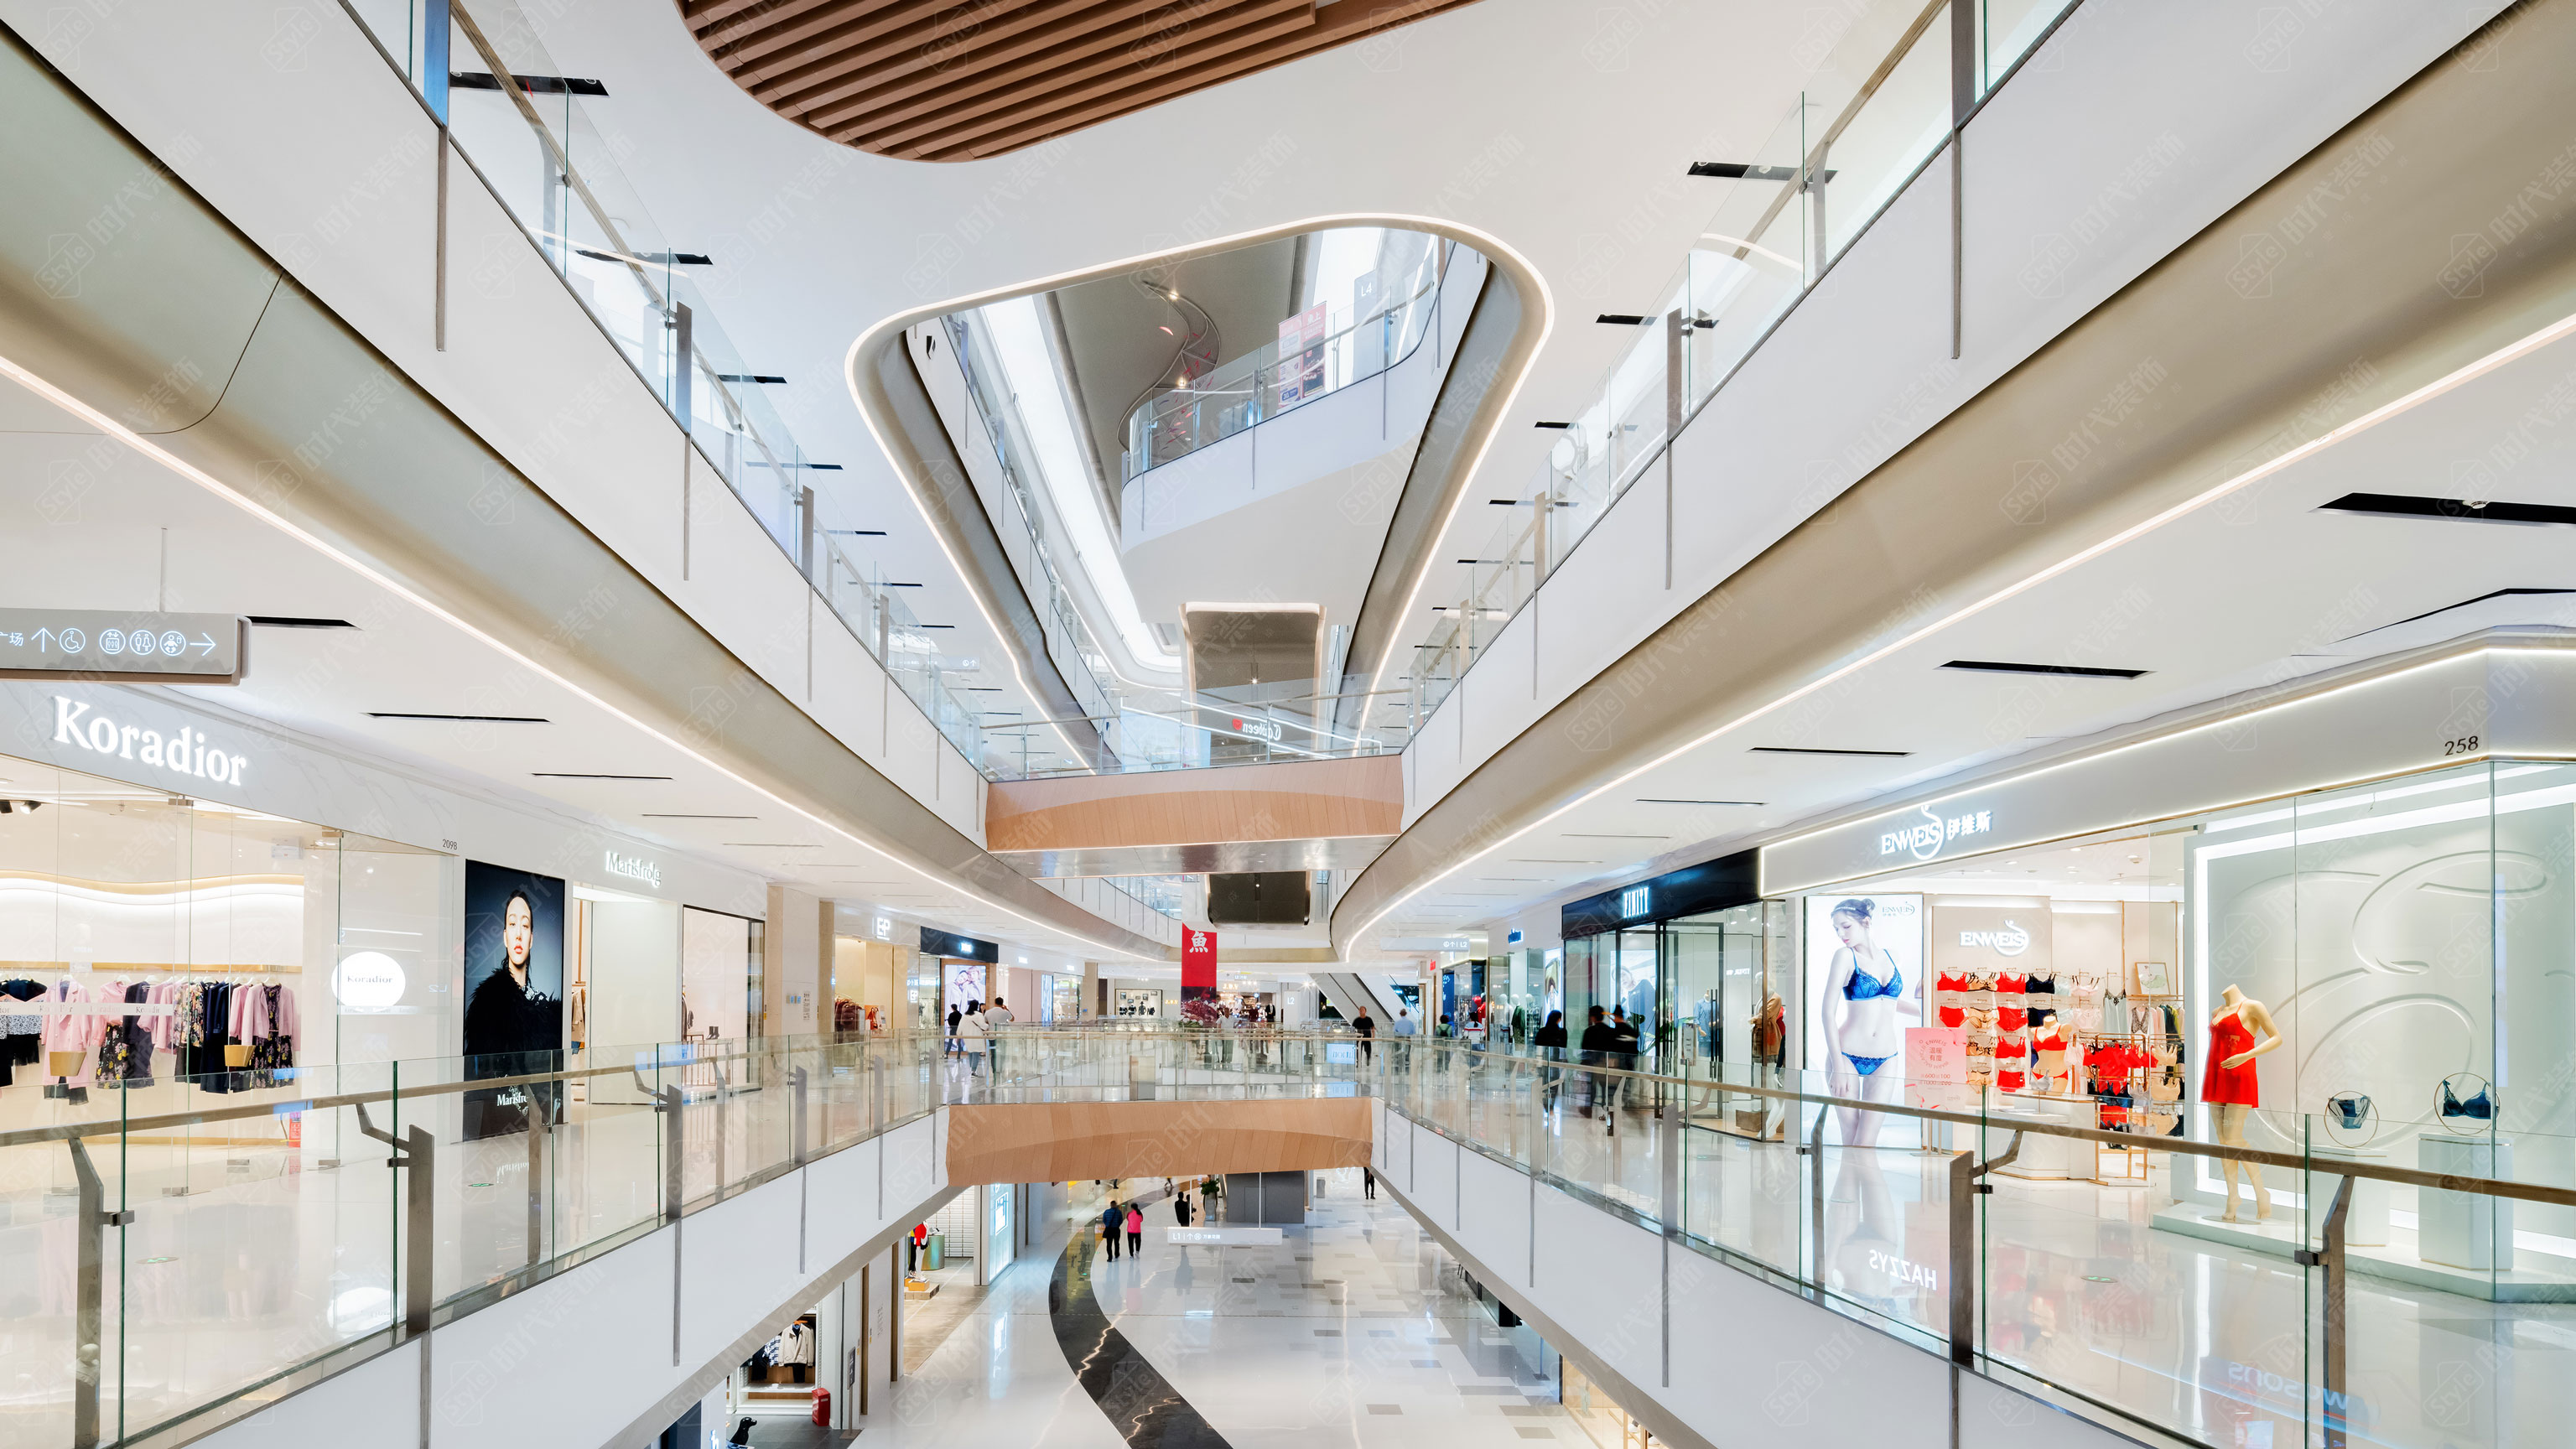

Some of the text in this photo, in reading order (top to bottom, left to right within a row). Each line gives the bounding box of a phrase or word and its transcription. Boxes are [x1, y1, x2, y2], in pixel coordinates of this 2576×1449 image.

[1361, 282, 1373, 297] L4
[52, 695, 247, 787] Koradior
[2444, 735, 2479, 756] 258
[1881, 808, 1993, 860] ENWEIS 伊维斯
[605, 850, 662, 887] Marisfrolg
[876, 917, 890, 939] EP
[1959, 920, 2030, 957] ENWEIS
[347, 974, 393, 984] Koradior
[1287, 997, 1296, 1005] L2
